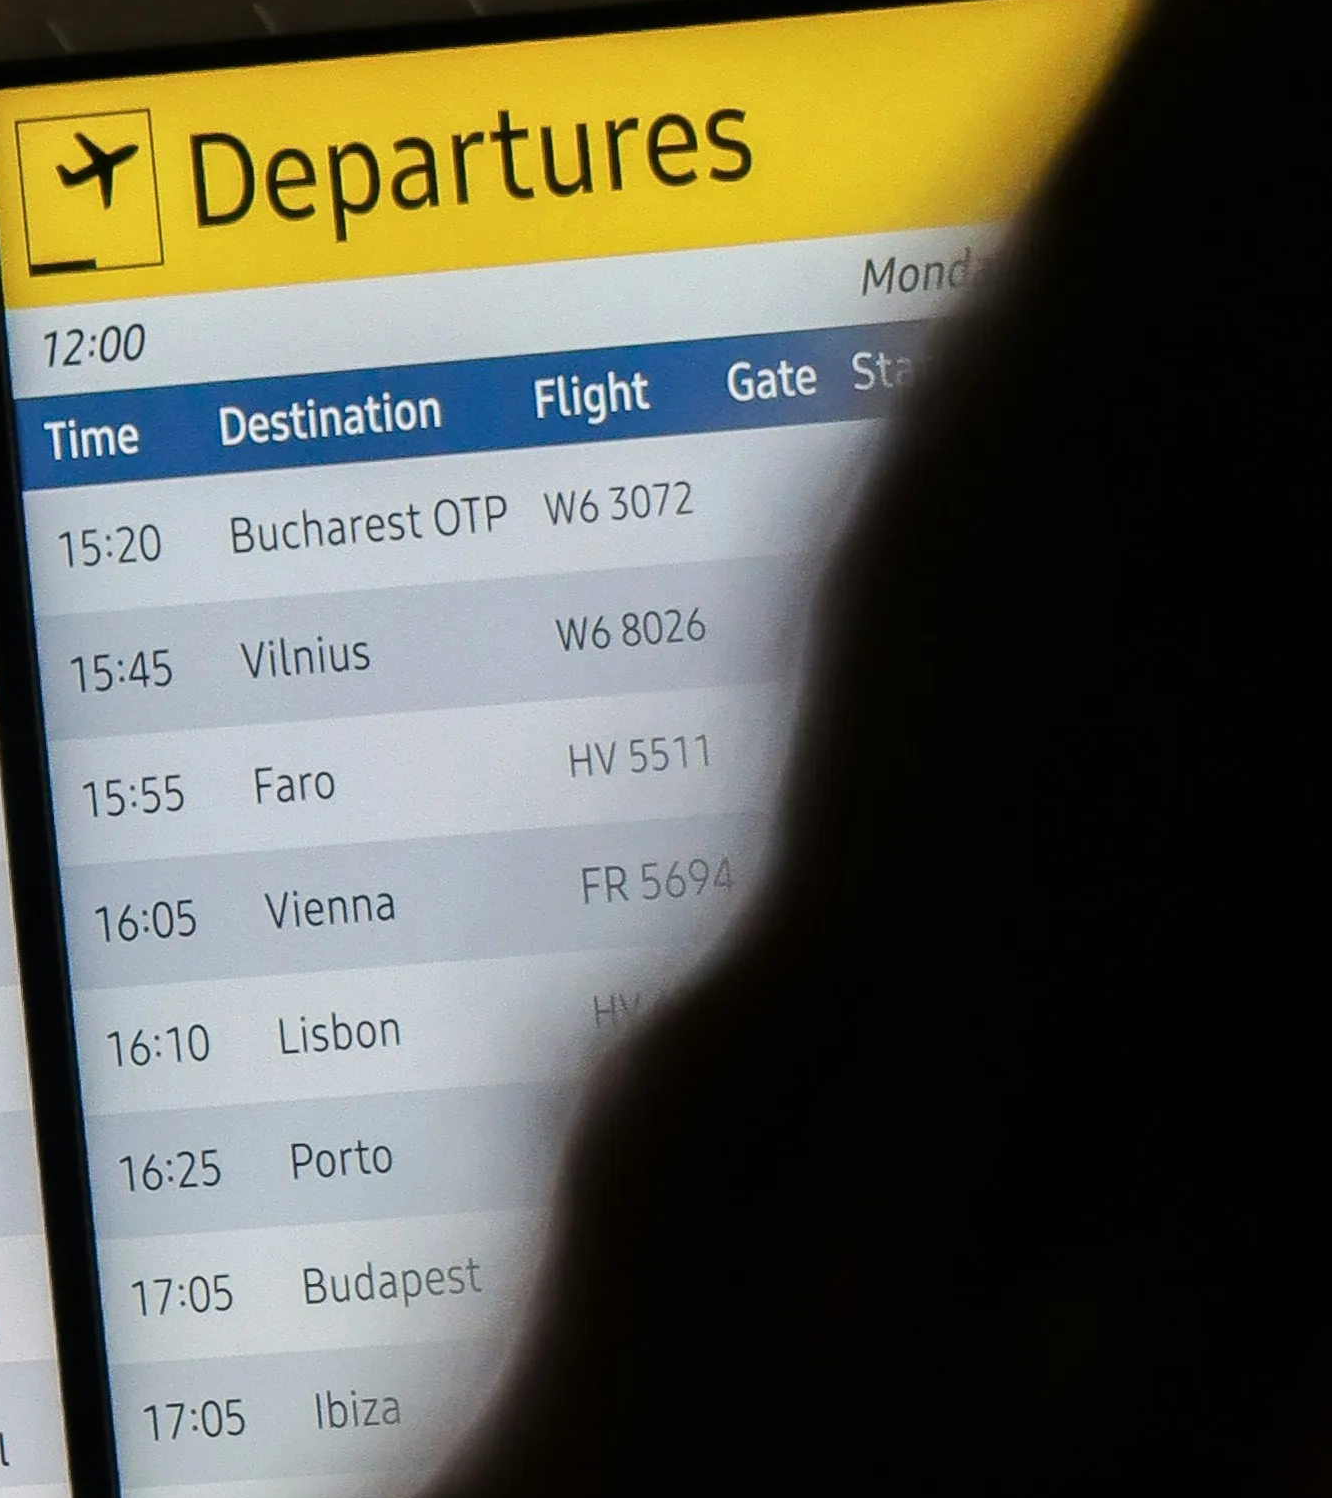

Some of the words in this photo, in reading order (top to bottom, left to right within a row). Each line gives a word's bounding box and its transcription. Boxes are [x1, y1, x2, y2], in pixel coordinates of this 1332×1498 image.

[188, 107, 754, 244] Departures
[43, 321, 147, 369] 12:00
[43, 419, 139, 460] Time
[219, 392, 442, 446] Destination
[534, 370, 651, 428] Flight
[727, 360, 818, 402] Gate
[229, 503, 424, 555] Bucharest
[432, 493, 509, 538] OTP
[542, 488, 601, 527] W6
[608, 479, 694, 522] 3072
[57, 522, 163, 569] 15:20
[69, 647, 174, 694] 15:45
[239, 634, 372, 680] Vilnius
[81, 773, 186, 819] 15:55
[253, 765, 336, 805] Faro
[93, 898, 198, 944] 16:05
[263, 889, 397, 930] Vienna
[106, 1022, 212, 1068] 16:10
[277, 1011, 402, 1056] Lisbon
[118, 1147, 223, 1193] 16:25
[290, 1139, 394, 1181] Porto
